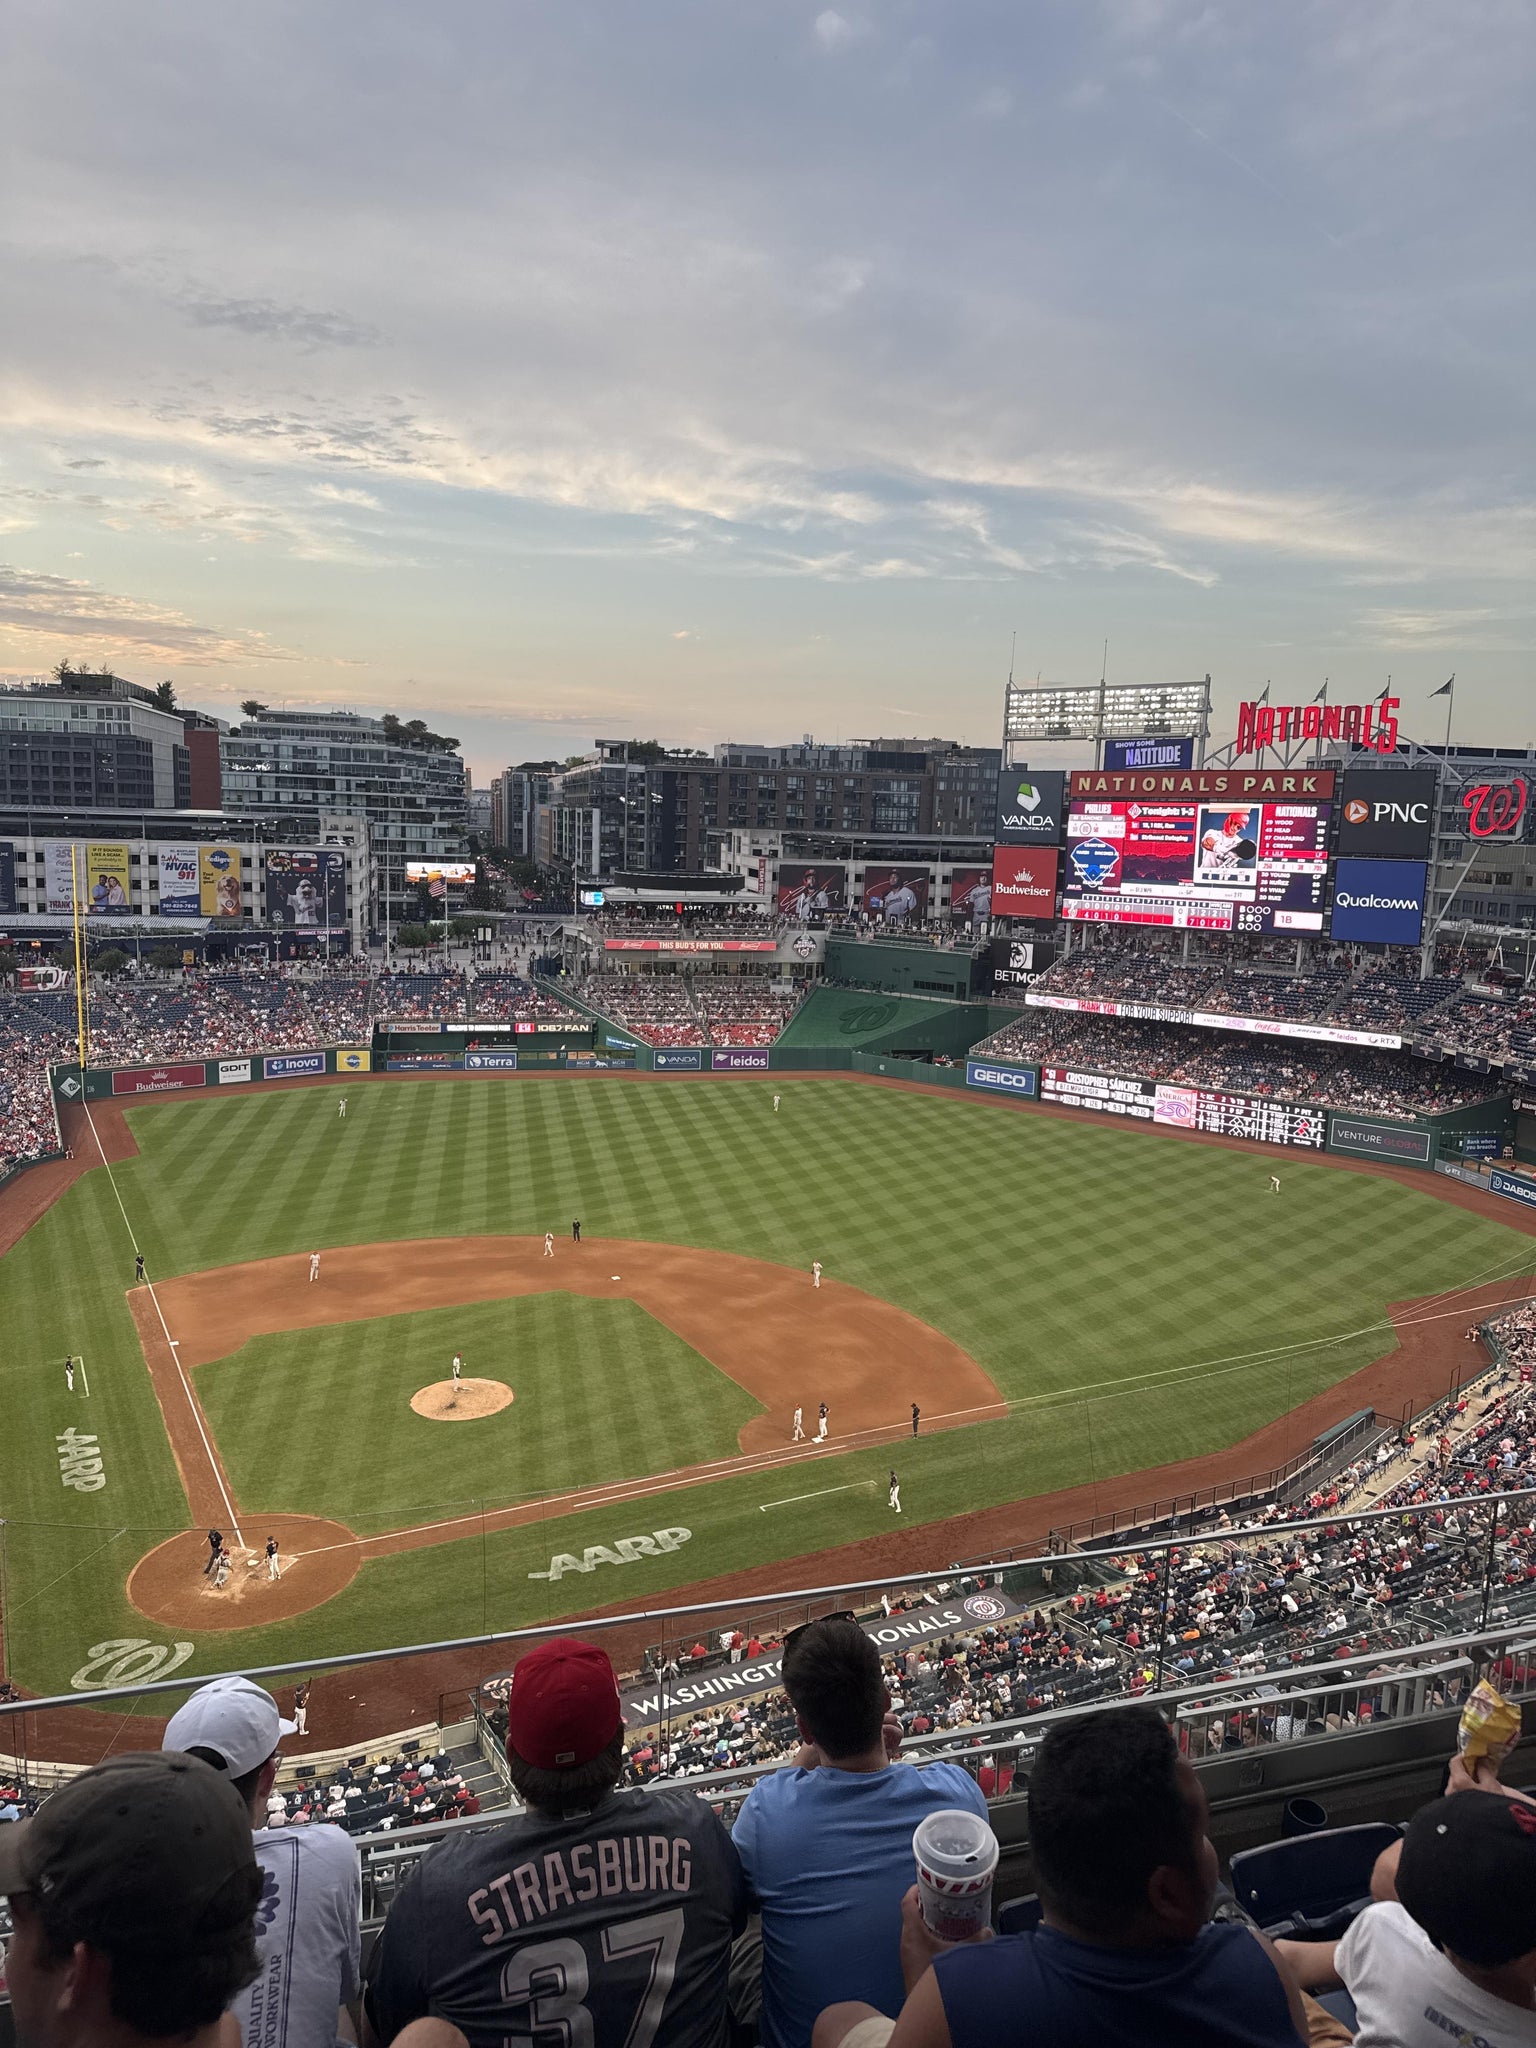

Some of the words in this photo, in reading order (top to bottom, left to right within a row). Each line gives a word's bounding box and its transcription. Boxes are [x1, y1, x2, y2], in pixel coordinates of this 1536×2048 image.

[1236, 697, 1400, 755] NATIONALS
[1125, 745, 1181, 766] NATITUDE
[1078, 777, 1228, 792] NATIONALS
[1243, 776, 1318, 792] PARK
[1084, 804, 1112, 814] PHILLIES
[1276, 806, 1318, 818] NATIONALS
[1373, 802, 1428, 823] PNC
[1001, 814, 1054, 826] VANDA
[178, 871, 196, 880] 911
[995, 883, 1051, 897] Budweiser
[1336, 892, 1418, 910] Qualcomm
[1078, 1000, 1100, 1013] THANK
[1103, 1002, 1118, 1015] YOU
[1121, 1004, 1134, 1016] FOR
[1137, 1006, 1157, 1020] YOUR
[1159, 1009, 1195, 1024] SUPPORT
[1336, 1033, 1358, 1042] leidos
[220, 1064, 249, 1072] GDIT
[286, 1059, 318, 1069] Inova
[482, 1057, 512, 1066] Terra
[730, 1056, 766, 1066] leidos
[136, 1080, 184, 1090] Budweiser
[974, 1069, 1026, 1088] GEICO
[1066, 1072, 1108, 1088] CRISTOPHER
[1109, 1078, 1142, 1094] SÁNCHEZ
[1157, 1093, 1188, 1102] AMERICA
[1156, 1100, 1190, 1118] 250
[1338, 1130, 1382, 1144] VENTURE
[1384, 1137, 1422, 1151] GLOBAL
[56, 1427, 106, 1492] AARP
[528, 1527, 692, 1581] AARP
[467, 1835, 691, 1945] STRASBURG
[500, 1908, 685, 2048] 37
[264, 1954, 282, 2048] WORKWEAR
[248, 1982, 264, 2048] QUALITY
